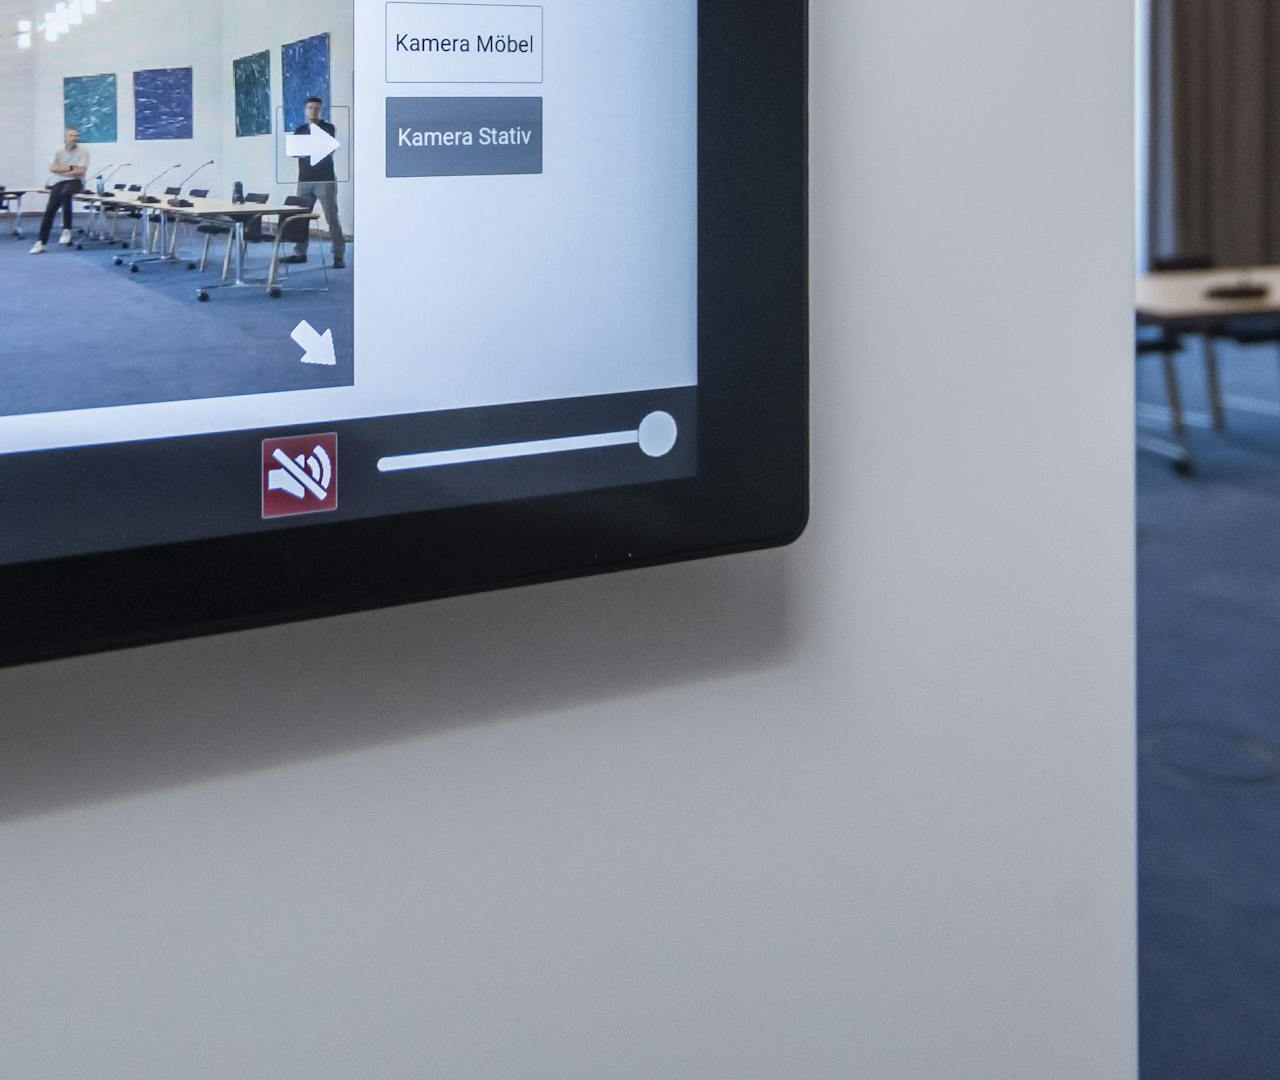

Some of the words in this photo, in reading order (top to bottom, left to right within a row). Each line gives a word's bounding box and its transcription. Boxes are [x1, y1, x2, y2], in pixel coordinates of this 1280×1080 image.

[396, 33, 470, 52] Kamera
[477, 34, 534, 54] Möbel
[398, 127, 473, 147] Kamera
[478, 126, 532, 145] Stativ
